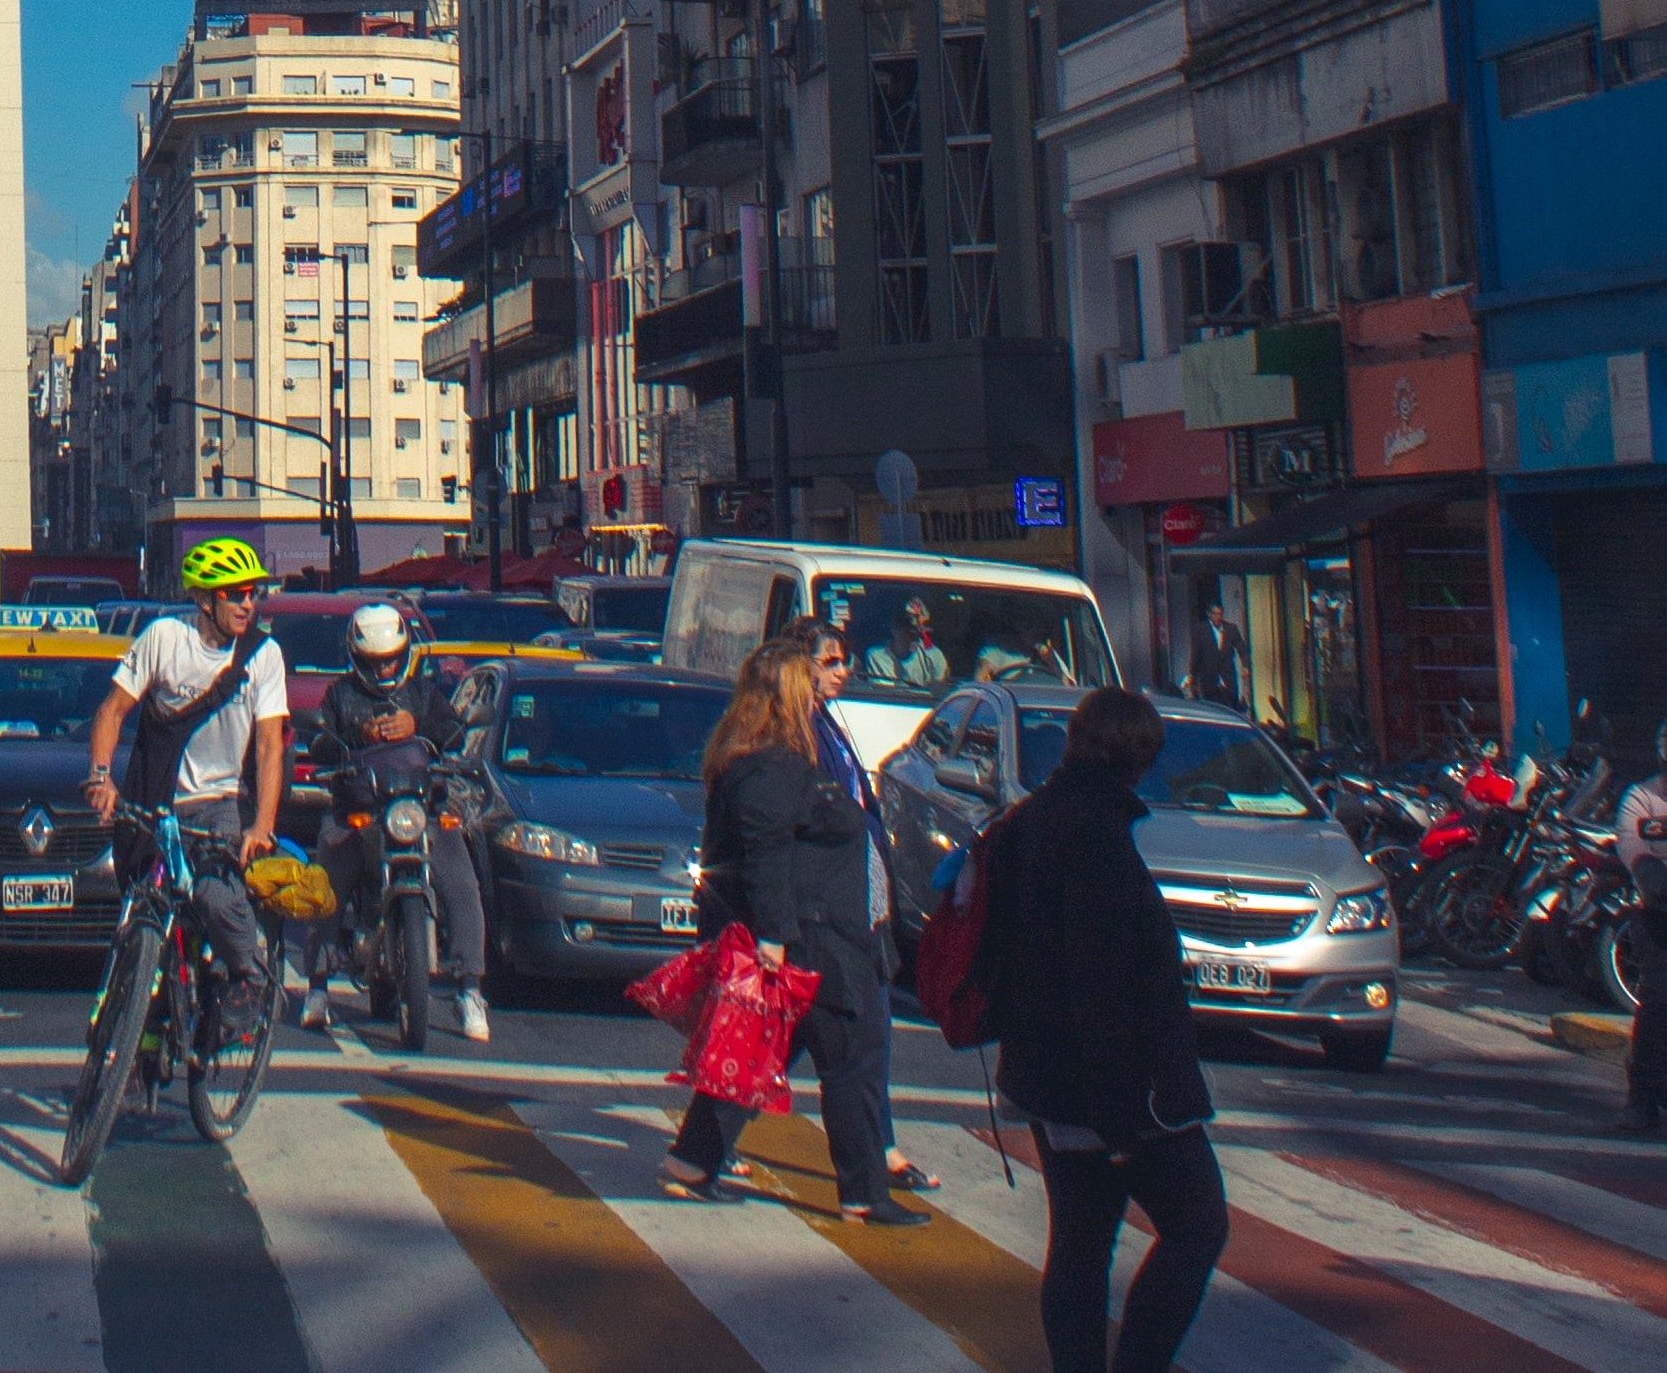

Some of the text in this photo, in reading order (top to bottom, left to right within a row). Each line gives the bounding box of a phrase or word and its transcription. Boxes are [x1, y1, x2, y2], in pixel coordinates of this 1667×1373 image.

[38, 610, 92, 626] TAXI
[6, 883, 70, 904] NSR 347
